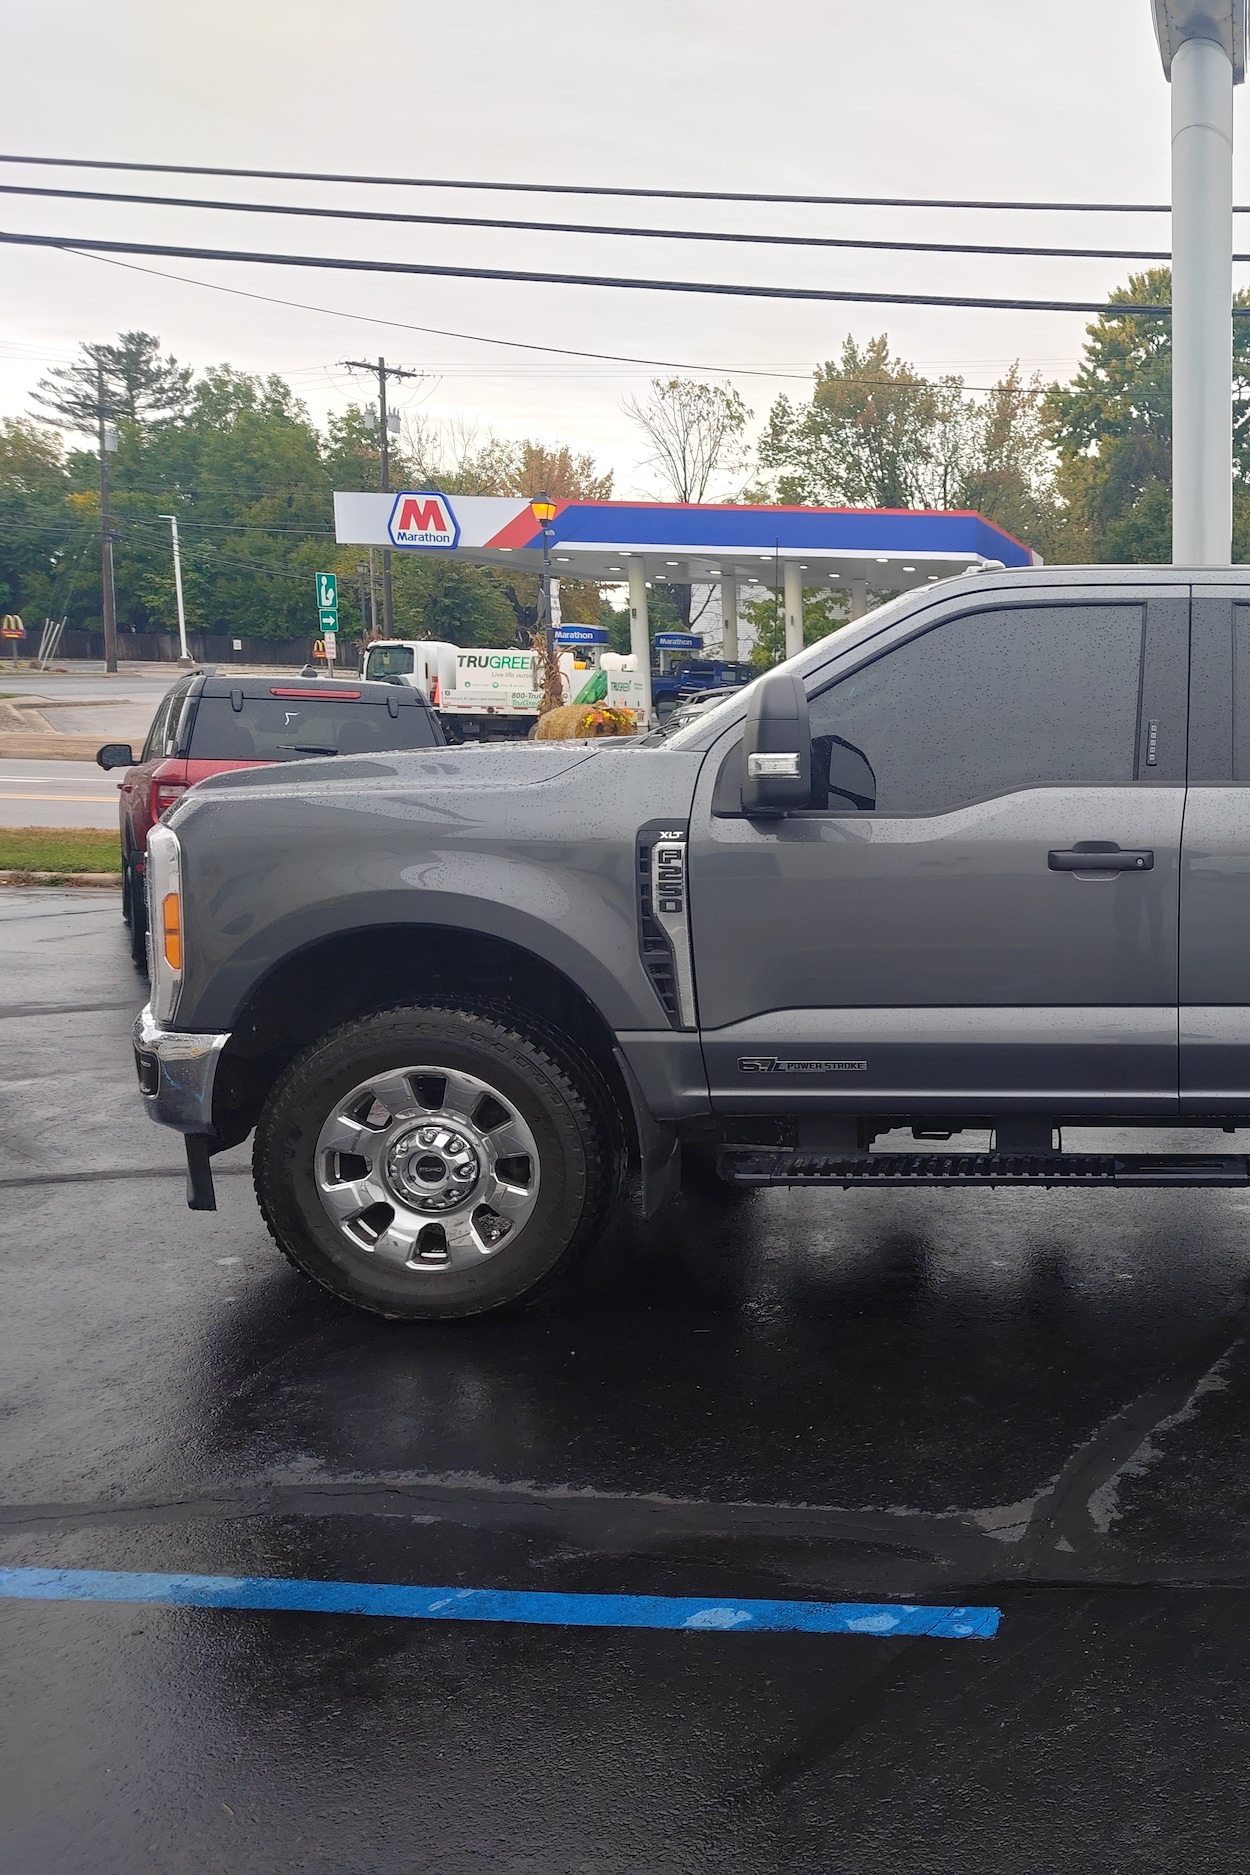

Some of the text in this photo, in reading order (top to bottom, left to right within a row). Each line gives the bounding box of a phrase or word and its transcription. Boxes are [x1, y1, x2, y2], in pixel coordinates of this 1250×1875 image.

[397, 531, 450, 543] Marathon
[554, 631, 593, 640] Marathon
[659, 637, 693, 646] Marathon
[659, 831, 684, 839] XLT
[787, 1062, 823, 1070] POWER
[825, 1062, 864, 1070] STROKE
